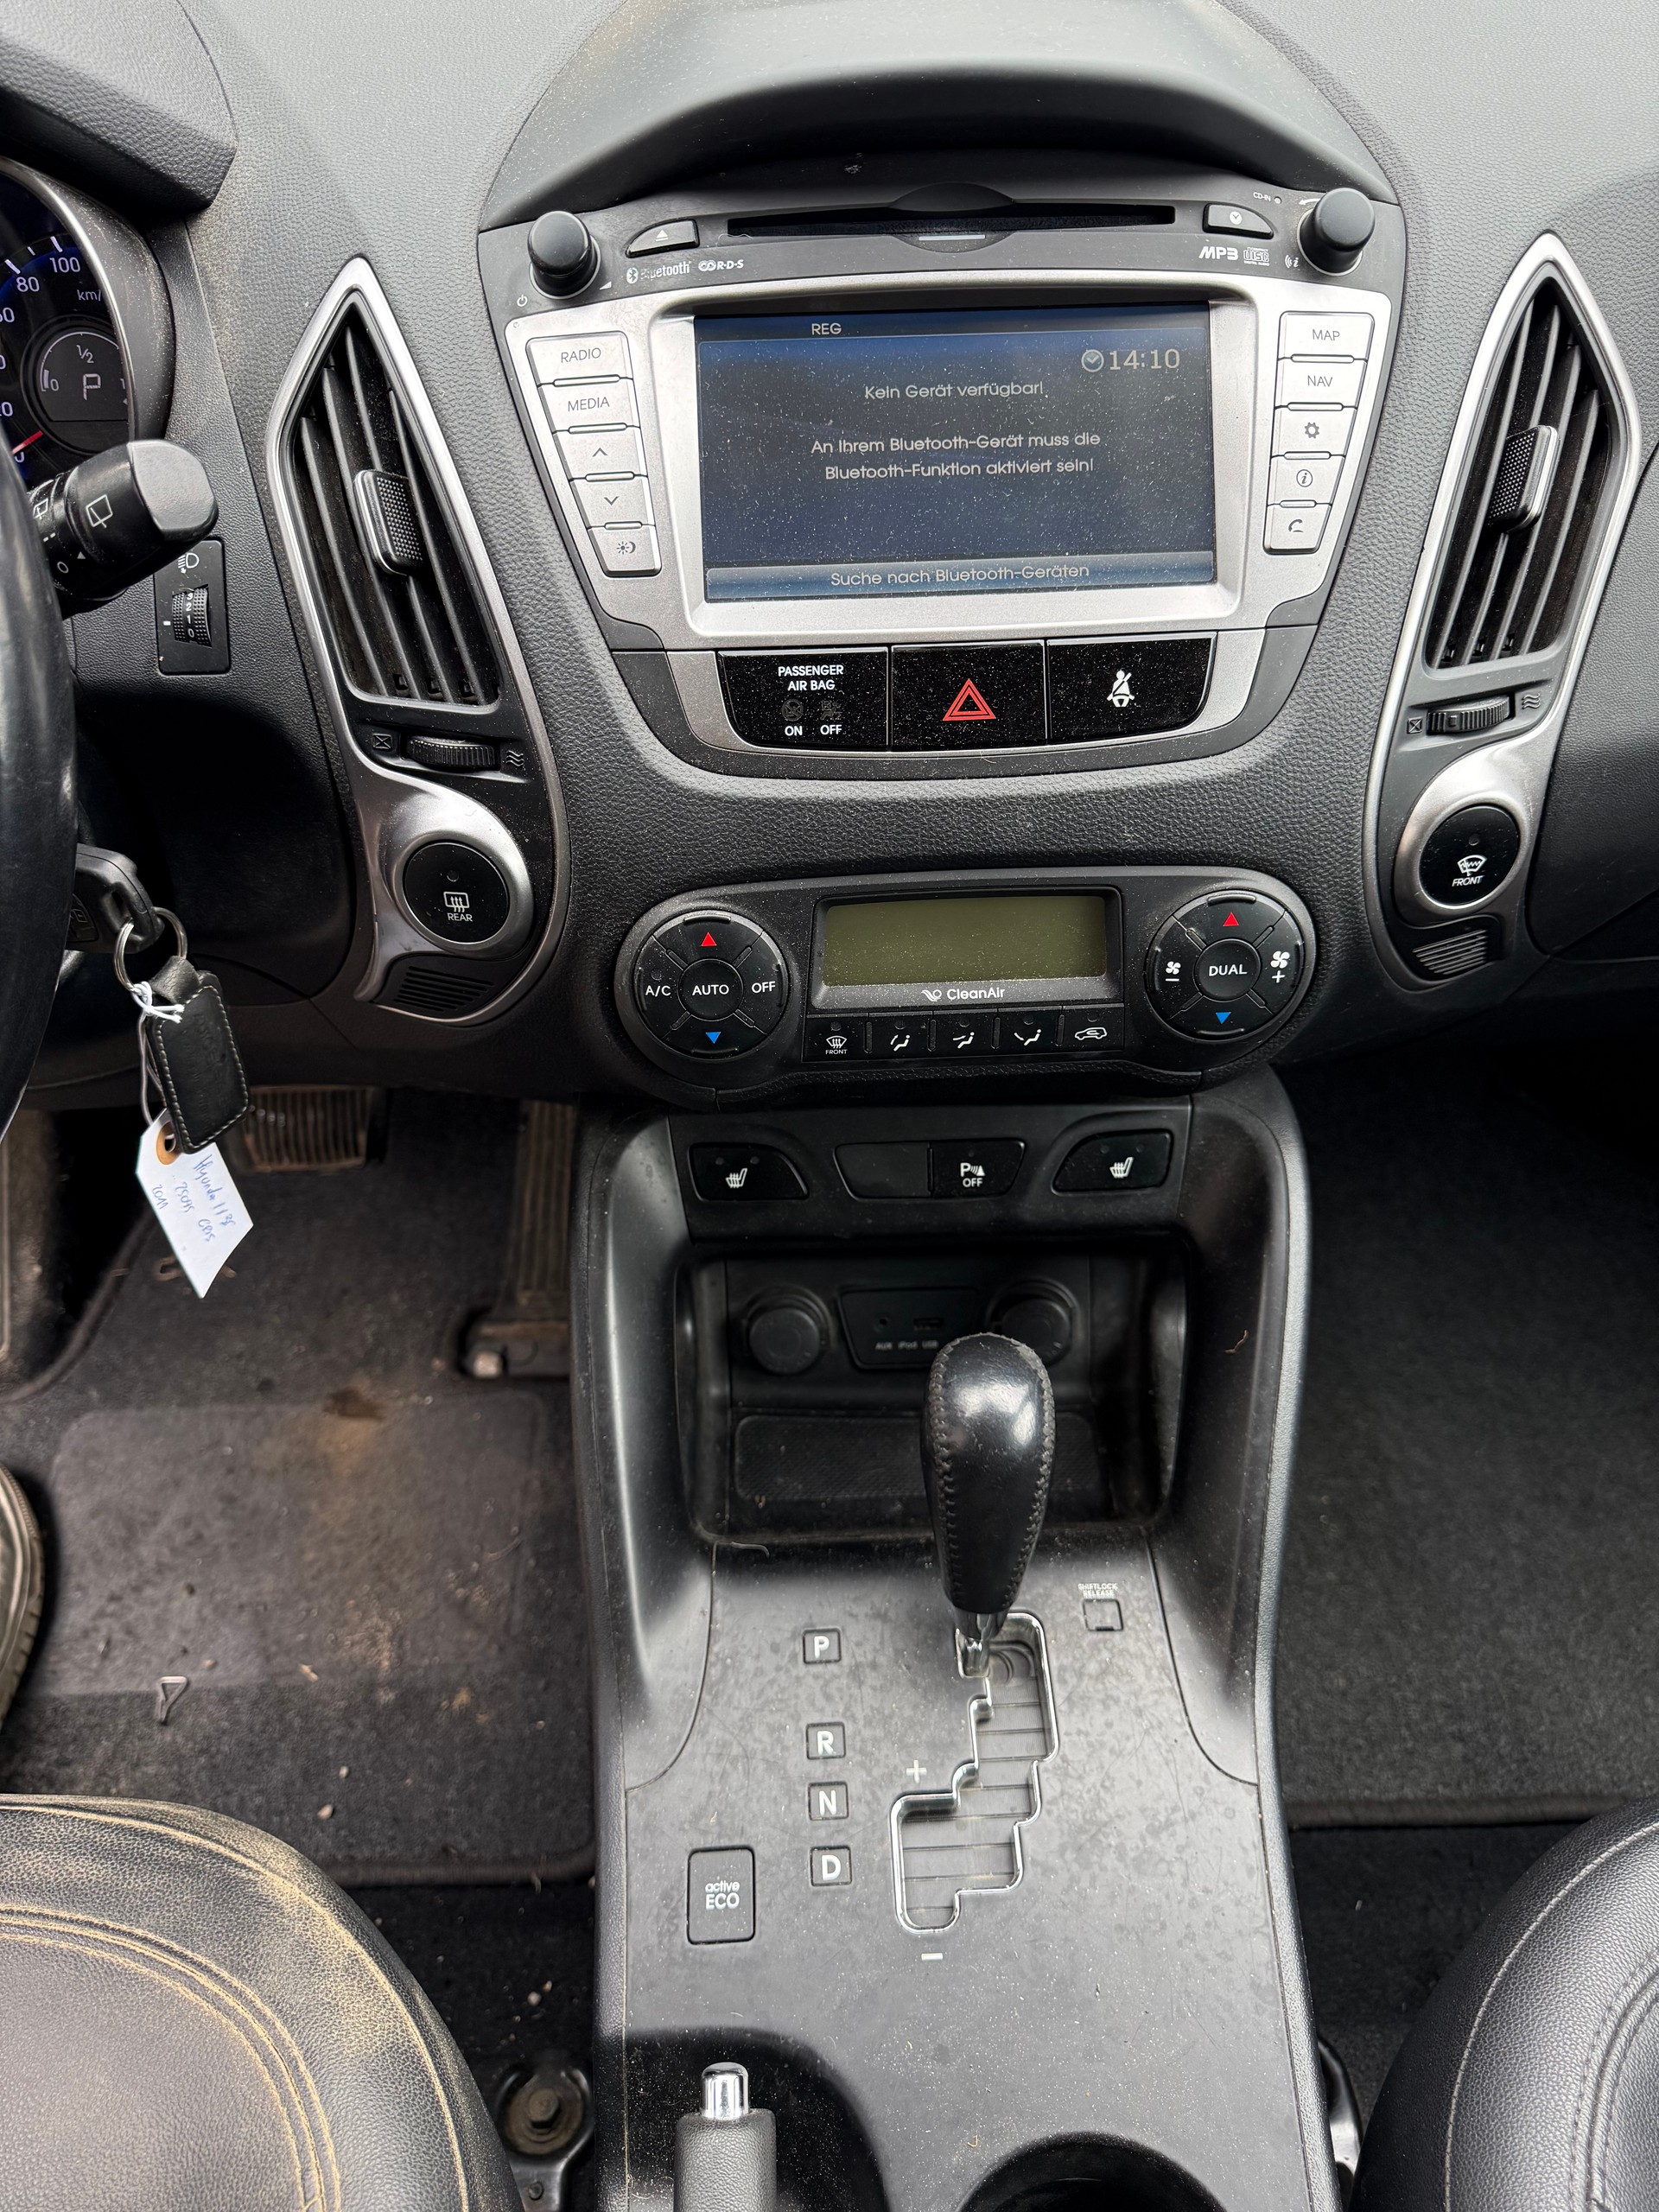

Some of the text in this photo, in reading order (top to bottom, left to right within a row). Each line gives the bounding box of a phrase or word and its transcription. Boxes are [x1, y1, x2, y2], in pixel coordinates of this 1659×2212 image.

[1252, 192, 1271, 202] CD-IN
[1198, 246, 1239, 261] MP3
[49, 257, 81, 273] 100
[16, 276, 40, 292] 80
[77, 289, 102, 302] km/
[0, 307, 15, 322] 0
[811, 322, 842, 335] REG
[1312, 329, 1340, 342] MAP
[560, 347, 601, 363] RADIO
[1109, 348, 1180, 370] 14:10
[50, 378, 60, 391] 0
[83, 373, 101, 400] P
[1306, 376, 1334, 388] NAV
[865, 381, 1044, 400] Kein Gerät verfügbar!
[0, 402, 13, 416] 0
[567, 397, 611, 413] MEDIA
[810, 432, 1101, 454] An Ihrem Bluetooth-Gerät muss die
[825, 458, 1094, 480] Bluetooth-Funktion aktiviert sein!
[830, 565, 1090, 587] Suche nach Bluetooth-Geräten
[186, 603, 192, 612] 2
[186, 614, 192, 624] 1
[778, 664, 844, 677] PASSENGER
[787, 679, 836, 691] AIR BAG
[785, 724, 842, 736] ON OFF
[1452, 875, 1484, 887] FRONT
[447, 912, 474, 922] REAR
[1209, 963, 1247, 976] DUAL
[645, 981, 776, 997] A/C AUTO OFF
[946, 986, 1006, 1001] CleanAir
[963, 1178, 983, 1188] OFF
[813, 1635, 830, 1658] P
[817, 1733, 835, 1756] R
[818, 1789, 837, 1815] N
[821, 1854, 842, 1881] D
[705, 1879, 741, 1892] active
[705, 1892, 741, 1910] ECO
